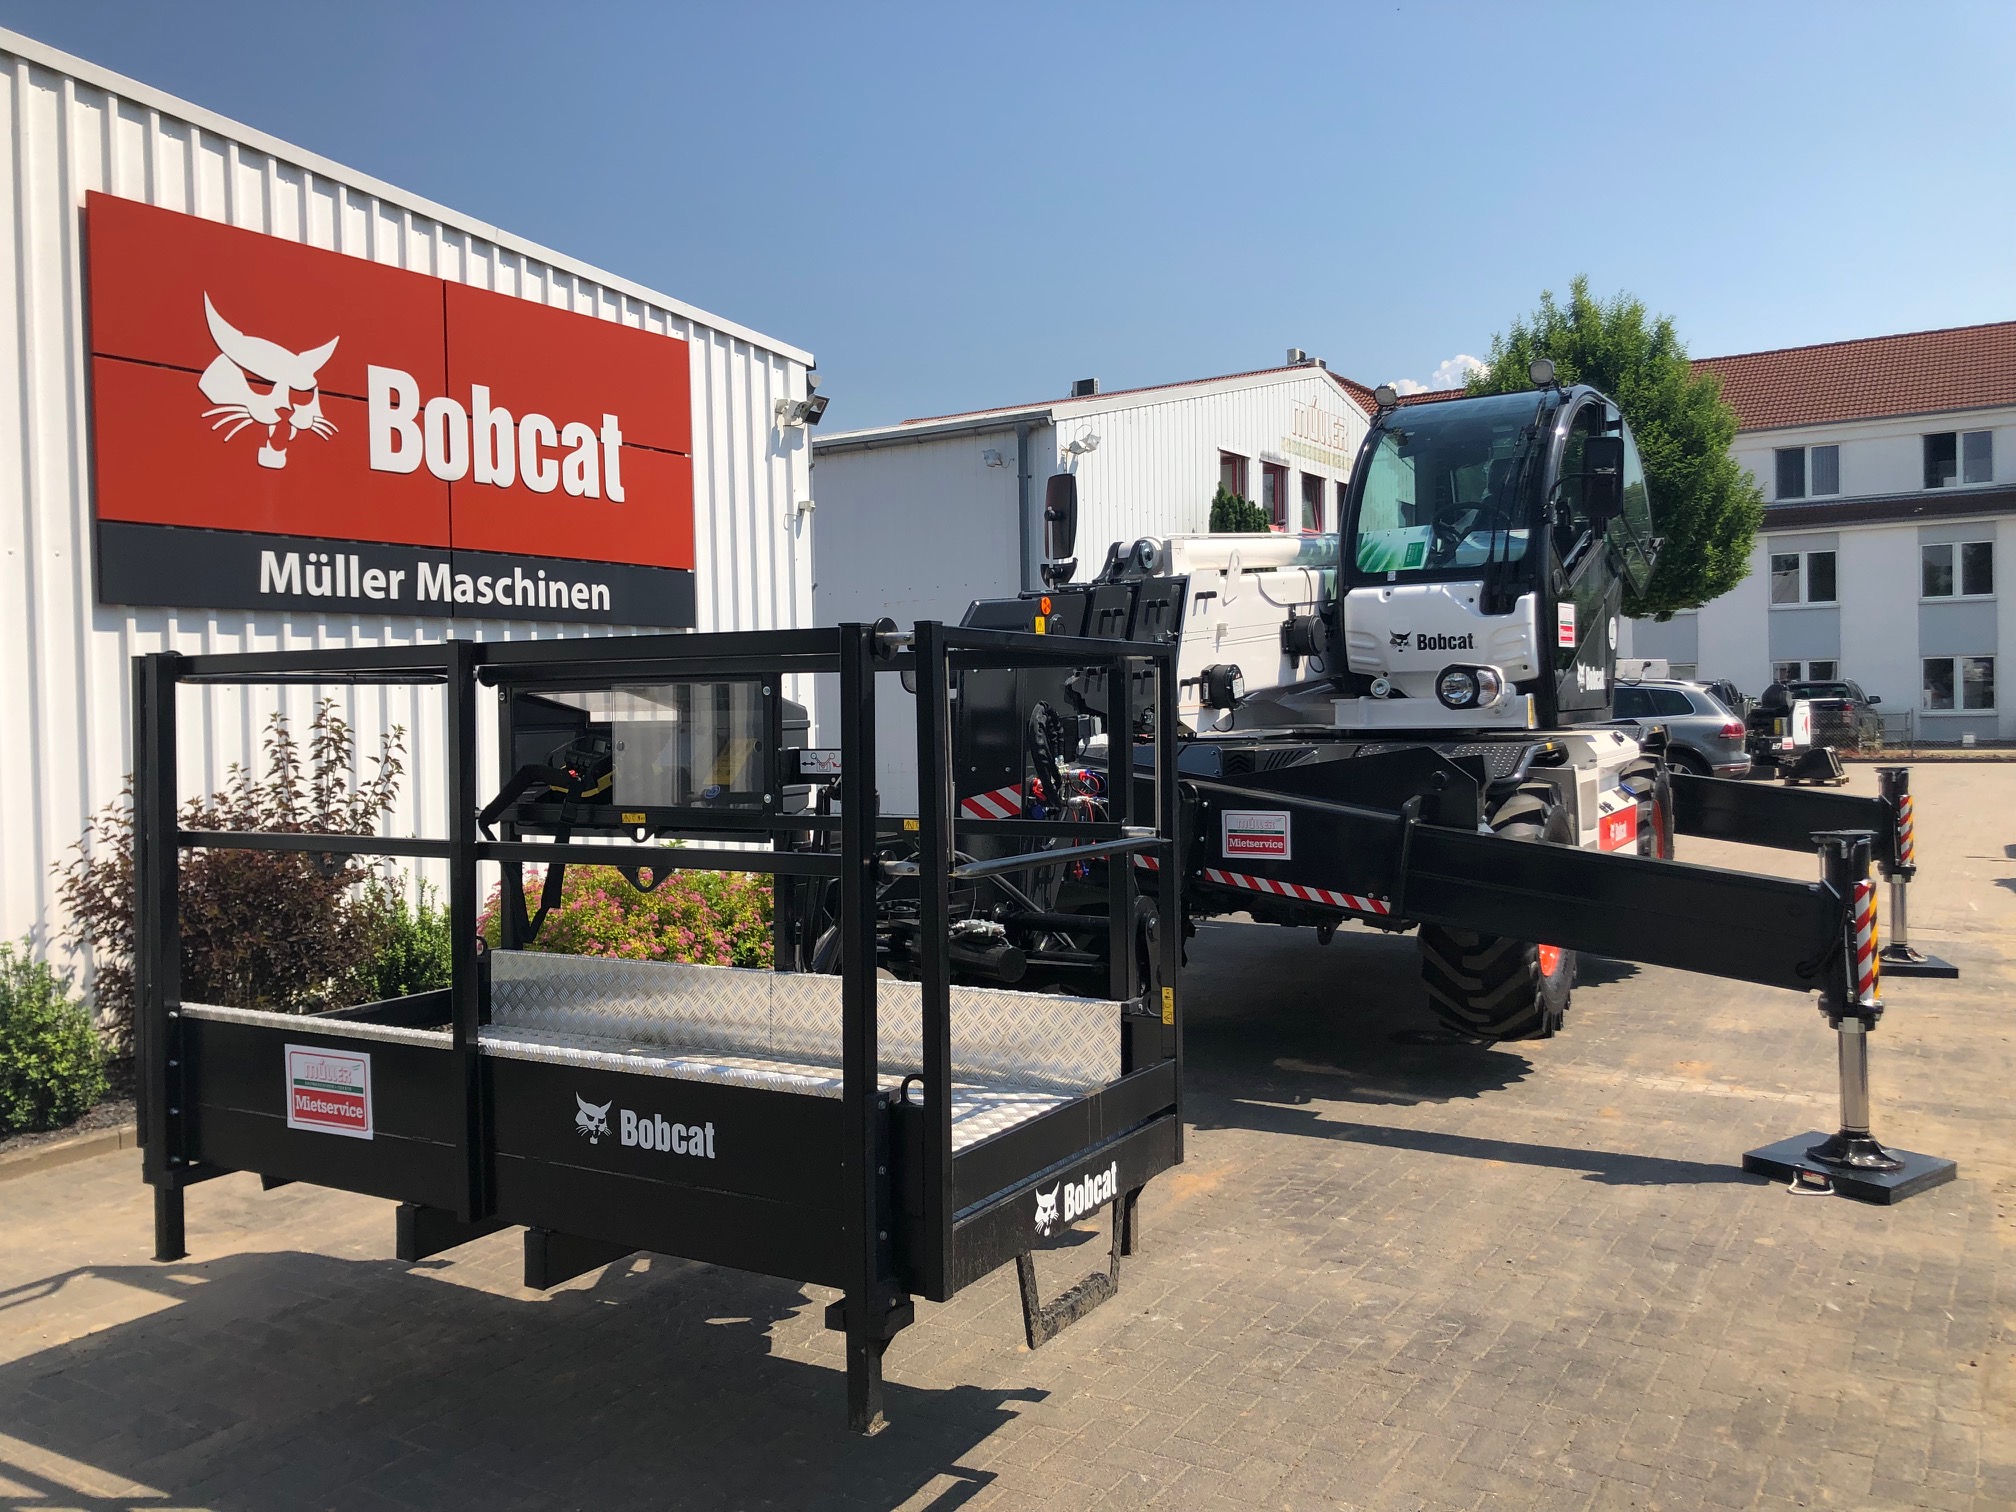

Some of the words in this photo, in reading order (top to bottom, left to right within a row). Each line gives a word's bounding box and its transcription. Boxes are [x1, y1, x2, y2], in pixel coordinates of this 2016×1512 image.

[367, 364, 625, 503] Bobcat
[259, 550, 406, 600] Müller
[416, 561, 611, 611] Maschinen
[1416, 632, 1474, 652] Bobcat
[1585, 666, 1605, 690] Bobcat
[1229, 838, 1283, 849] Mietservice
[295, 1095, 363, 1119] Mietservice
[620, 1108, 716, 1159] Bobcat
[1064, 1161, 1118, 1222] Bobcat
